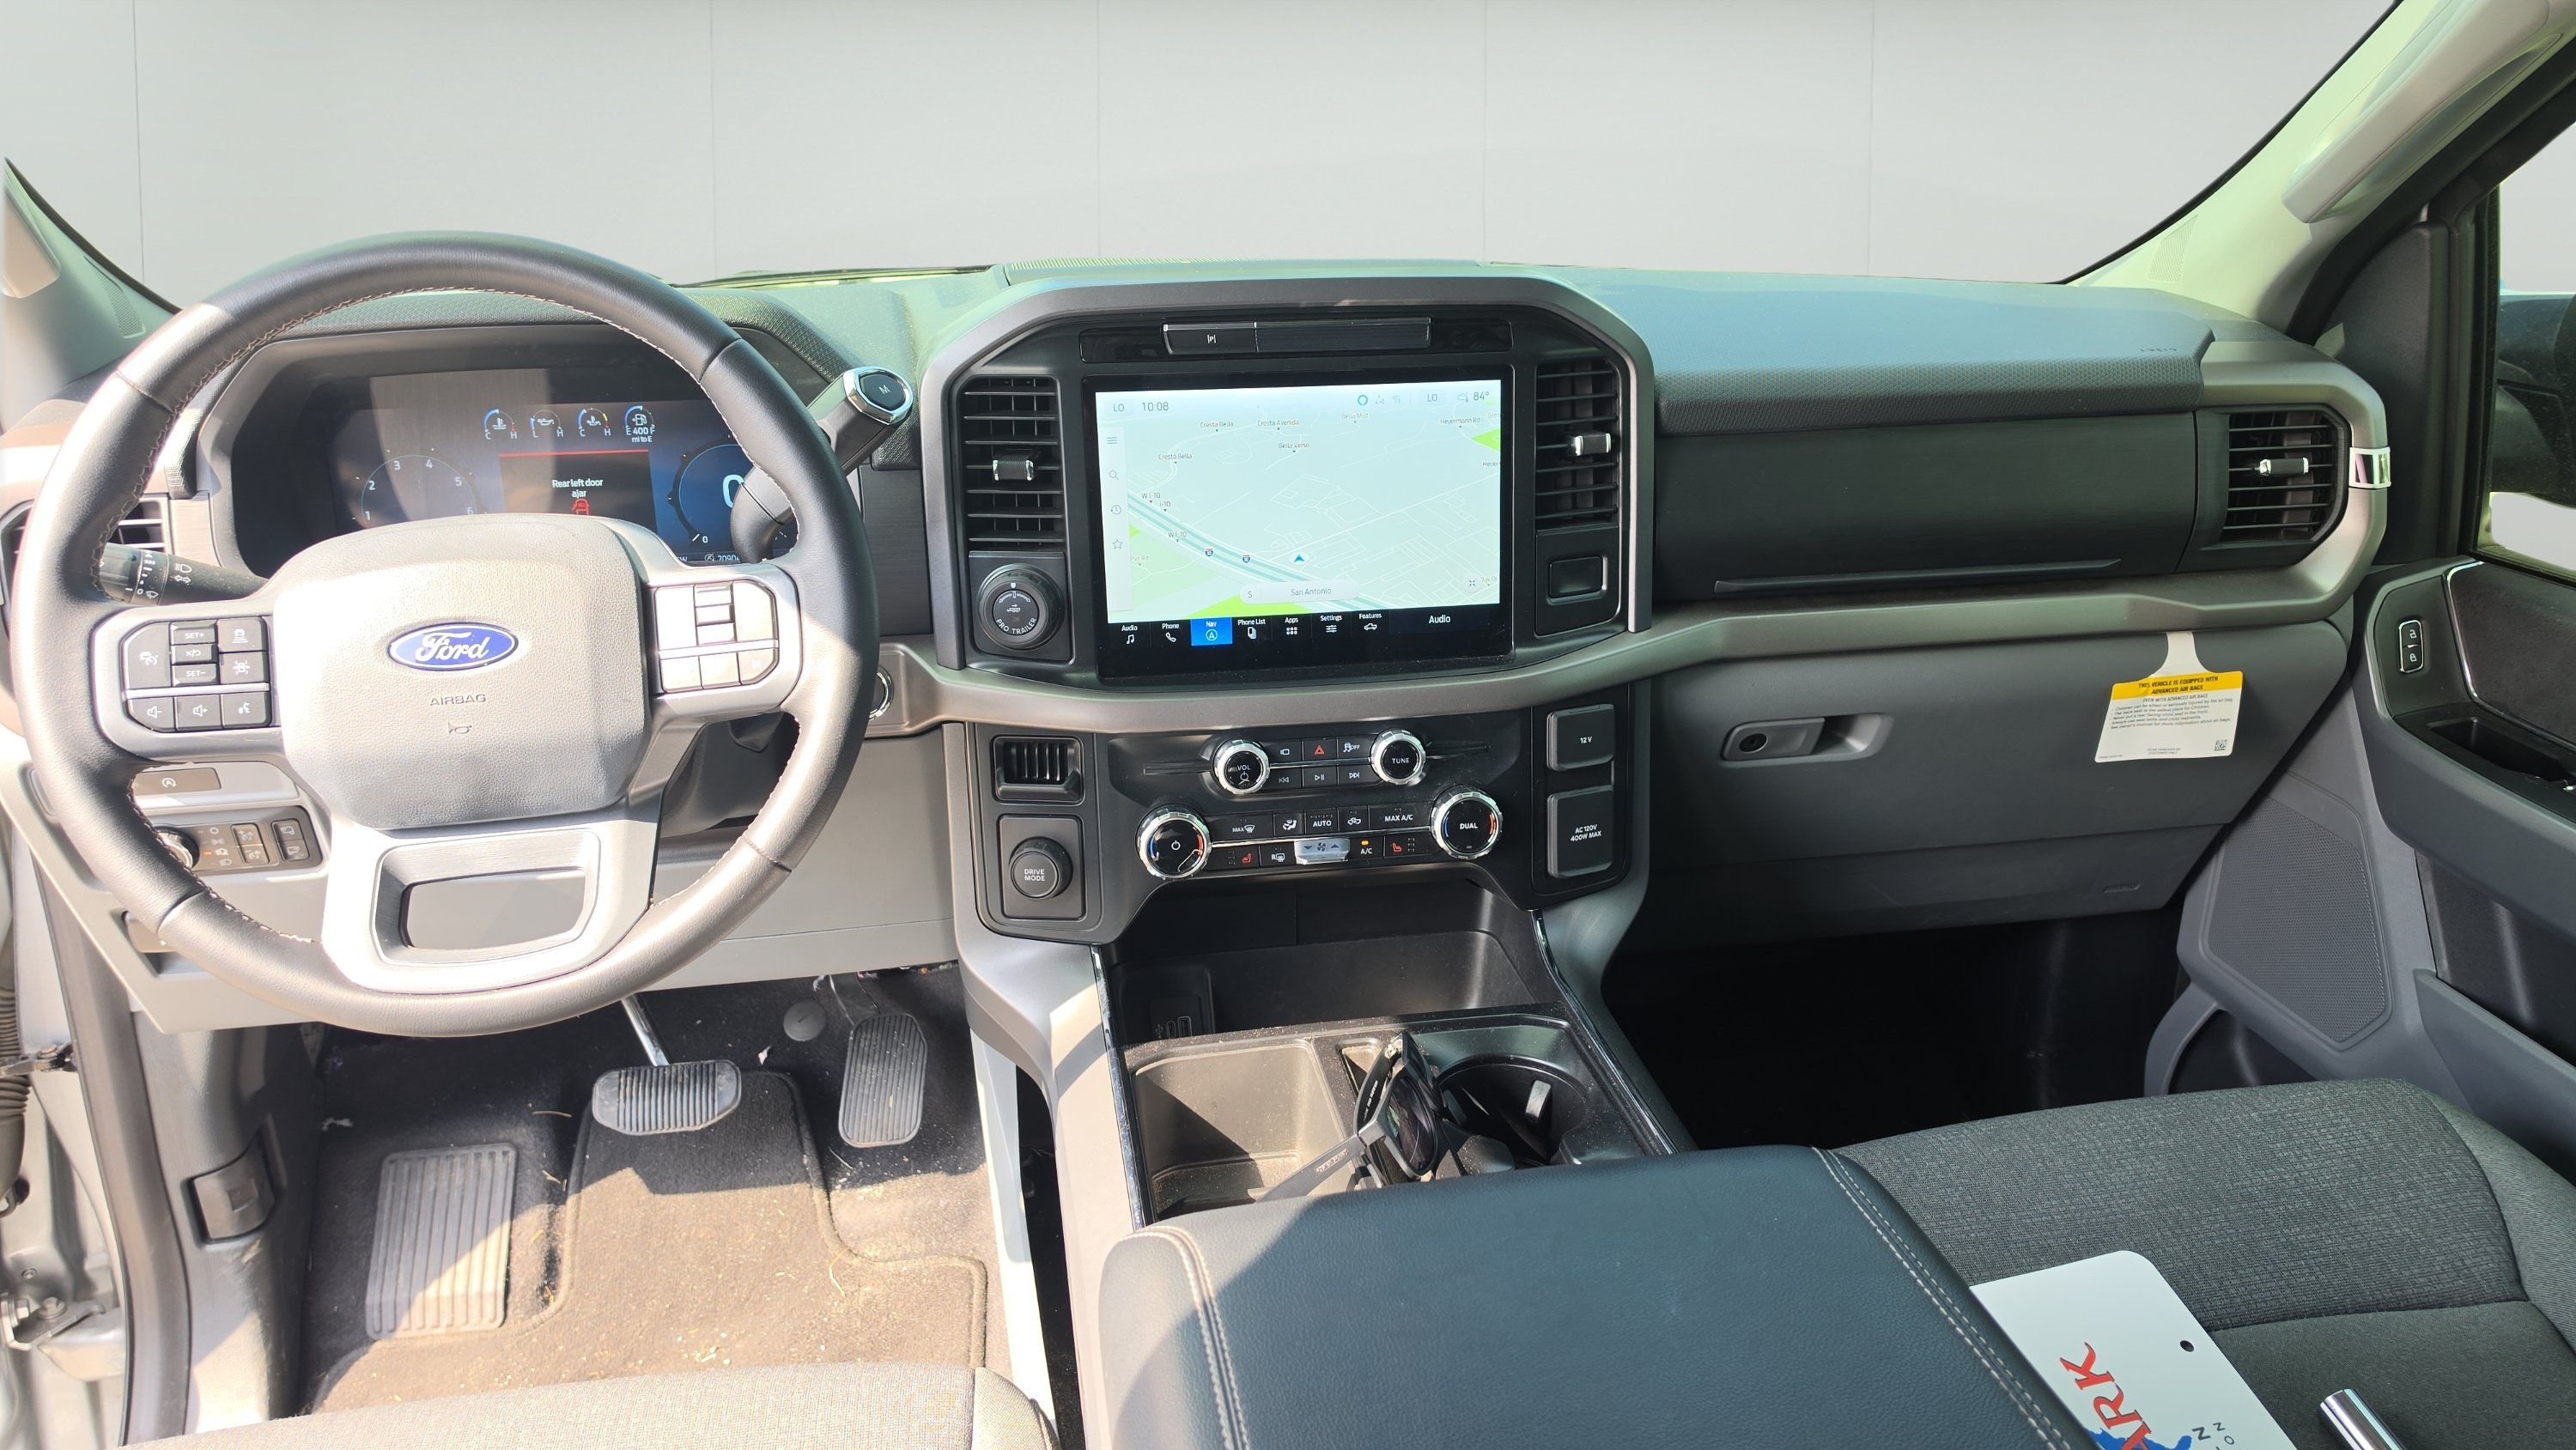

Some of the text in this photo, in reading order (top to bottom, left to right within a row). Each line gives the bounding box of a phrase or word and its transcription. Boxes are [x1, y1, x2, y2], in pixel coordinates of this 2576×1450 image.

[878, 385, 890, 395] M
[1113, 403, 1125, 412] LO
[1141, 402, 1170, 412] 10:08
[556, 429, 564, 438] H
[633, 427, 649, 435] 400
[393, 460, 401, 470] 3
[425, 459, 433, 469] 4
[368, 480, 375, 490] 2
[454, 476, 462, 486] 5
[552, 478, 604, 488] Rear left door
[571, 489, 587, 499] ajar
[365, 511, 371, 520] 1
[1291, 587, 1332, 597] San Antonio
[1429, 614, 1451, 624] Audio
[995, 617, 1037, 635] PRO TRAILER
[415, 631, 491, 662] Ford
[429, 694, 487, 707] AIRBAG
[1571, 830, 1602, 842] 400W MAX
[1361, 846, 1372, 855] A/C
